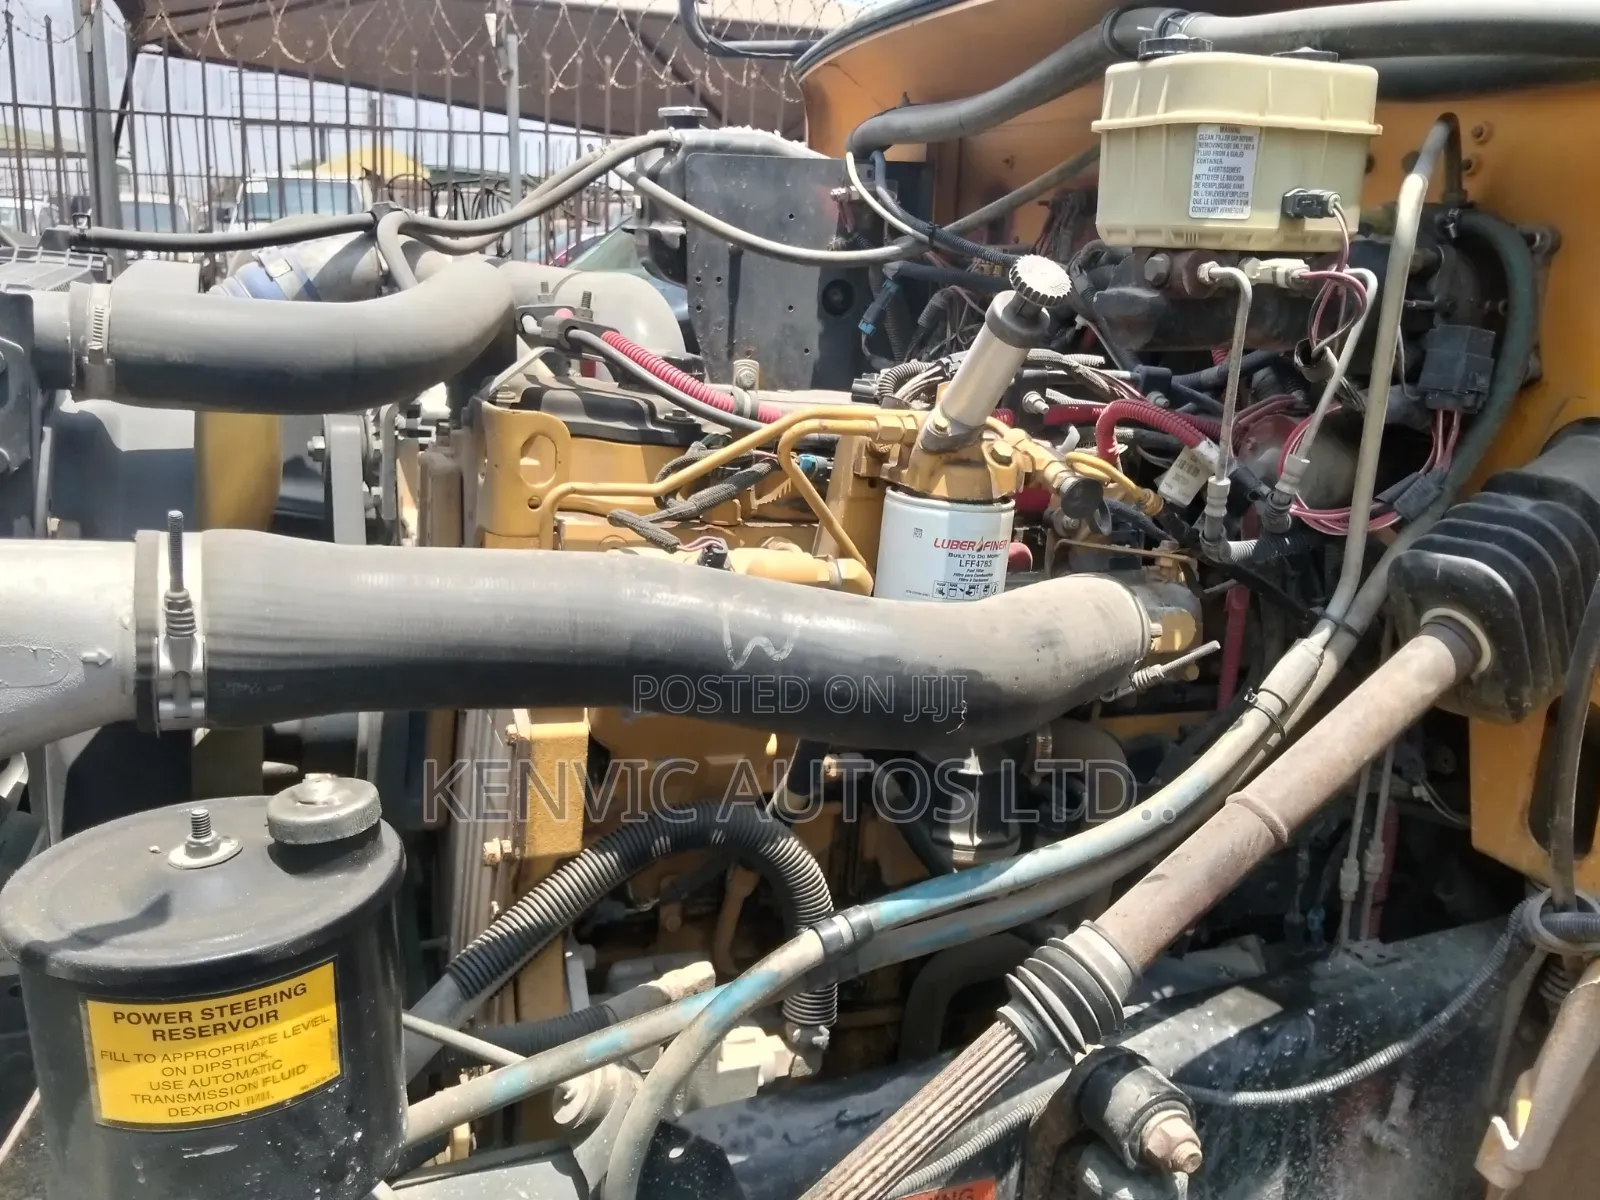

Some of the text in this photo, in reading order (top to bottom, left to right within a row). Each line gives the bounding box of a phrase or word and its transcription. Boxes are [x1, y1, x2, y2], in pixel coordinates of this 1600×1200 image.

[934, 538, 976, 551] LUBER
[959, 560, 992, 568] LFF4783
[113, 982, 307, 1025] POWER STEERING
[101, 1014, 330, 1063] FILL TO APPROPRIATE LEVEL
[152, 1009, 279, 1041] RESERVOIR
[150, 1080, 183, 1090] USE
[188, 1059, 283, 1088] AUTOMATIC
[162, 1050, 272, 1077] ON DIPSTICK.
[131, 1080, 258, 1104] TRANSMISSION
[262, 1063, 308, 1087] FLUID
[168, 1099, 240, 1118] DEXRON
